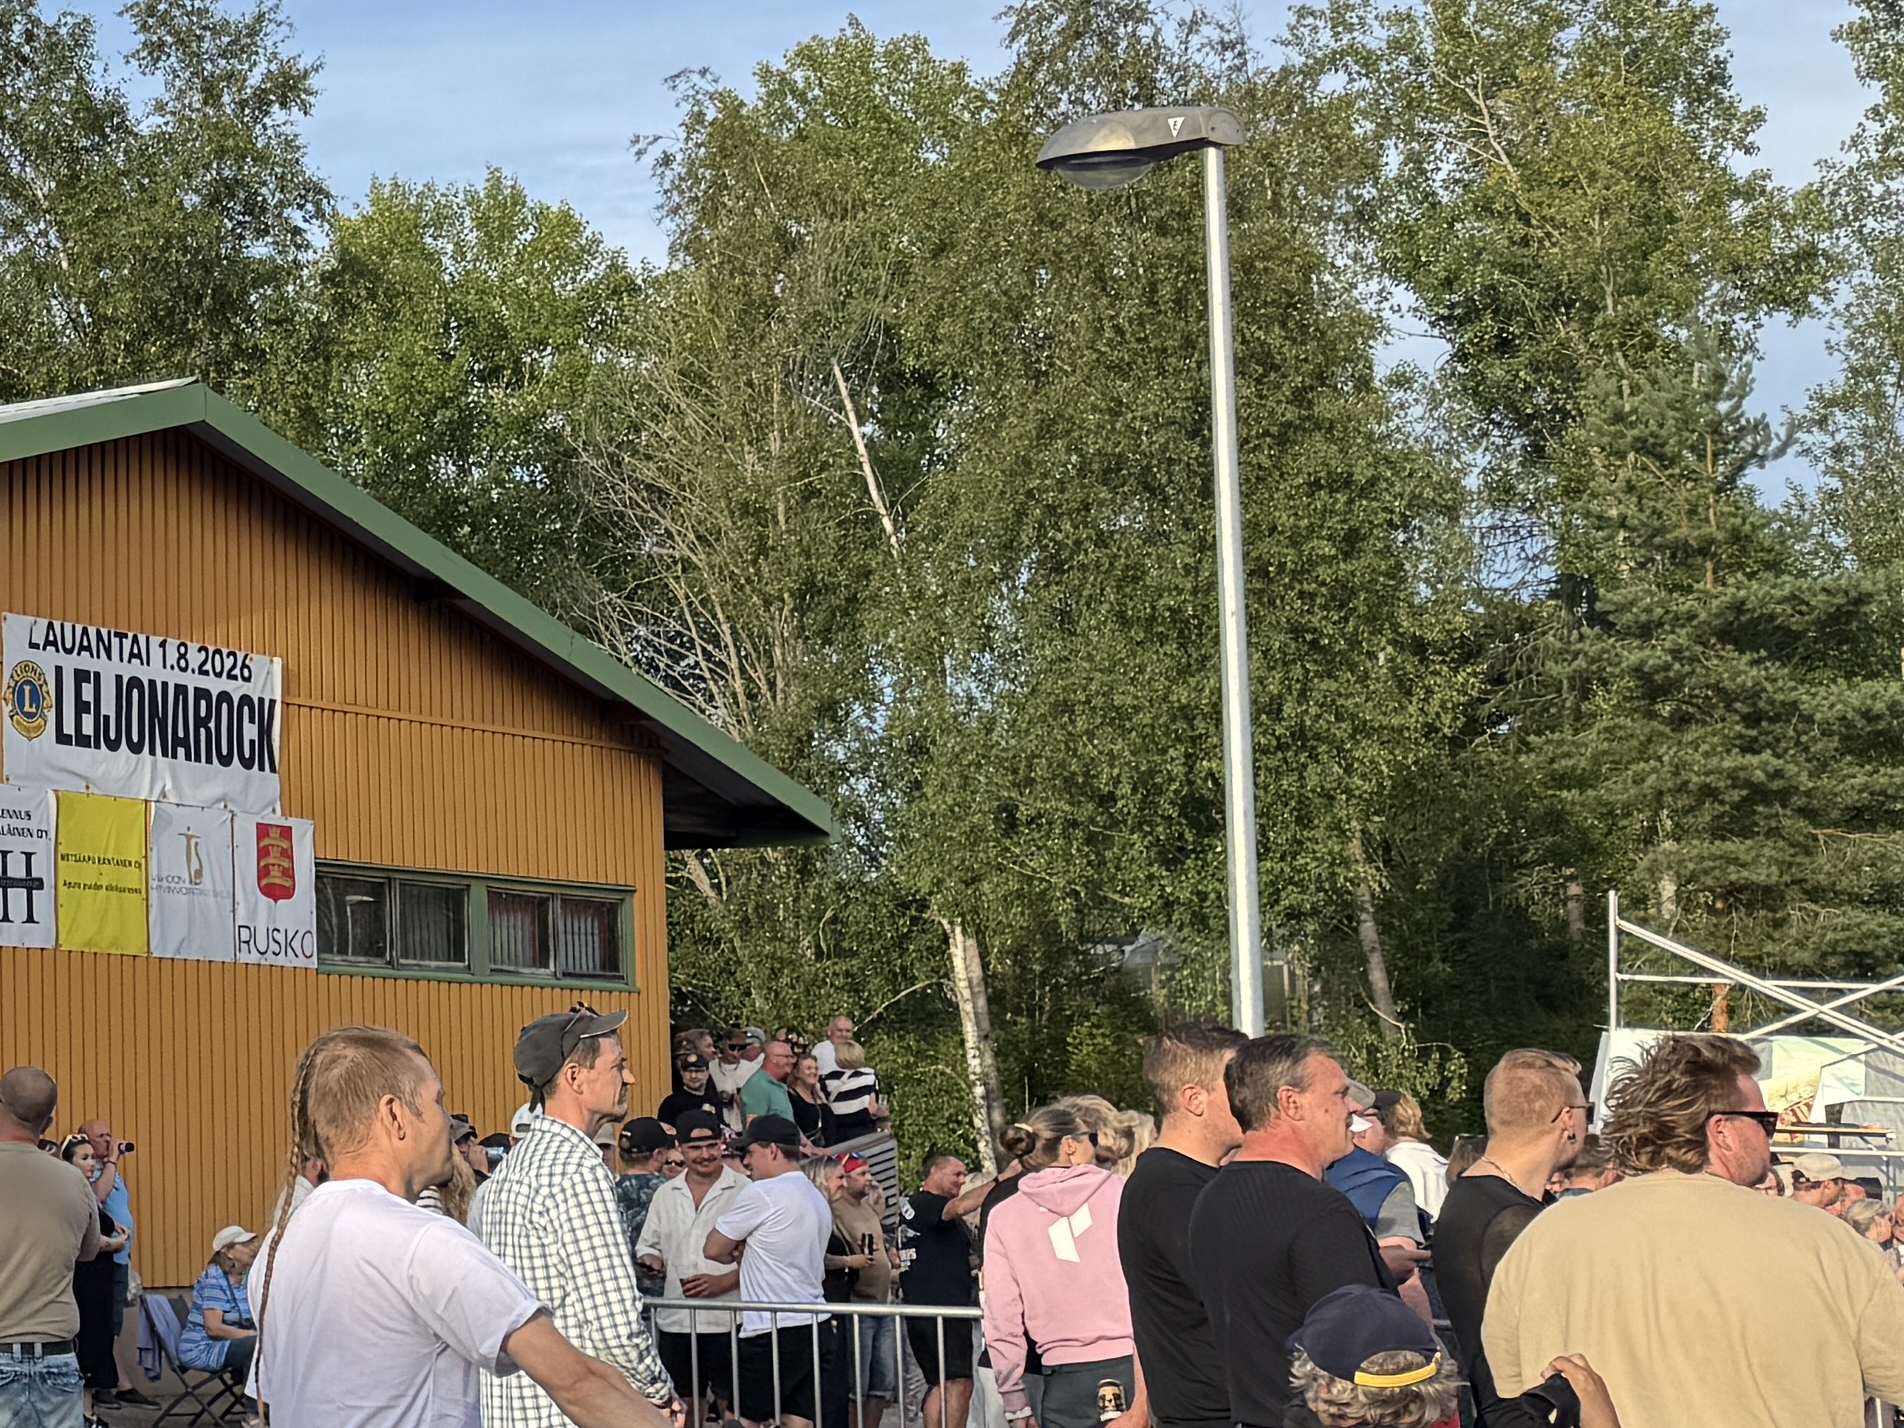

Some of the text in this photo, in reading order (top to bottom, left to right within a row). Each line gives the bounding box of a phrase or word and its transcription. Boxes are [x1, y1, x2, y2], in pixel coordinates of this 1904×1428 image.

[28, 621, 253, 683] LAUANTAI 1.8.2026
[23, 684, 37, 713] L
[54, 664, 278, 774] LEIJONAROCK
[237, 925, 314, 959] RUSKO
